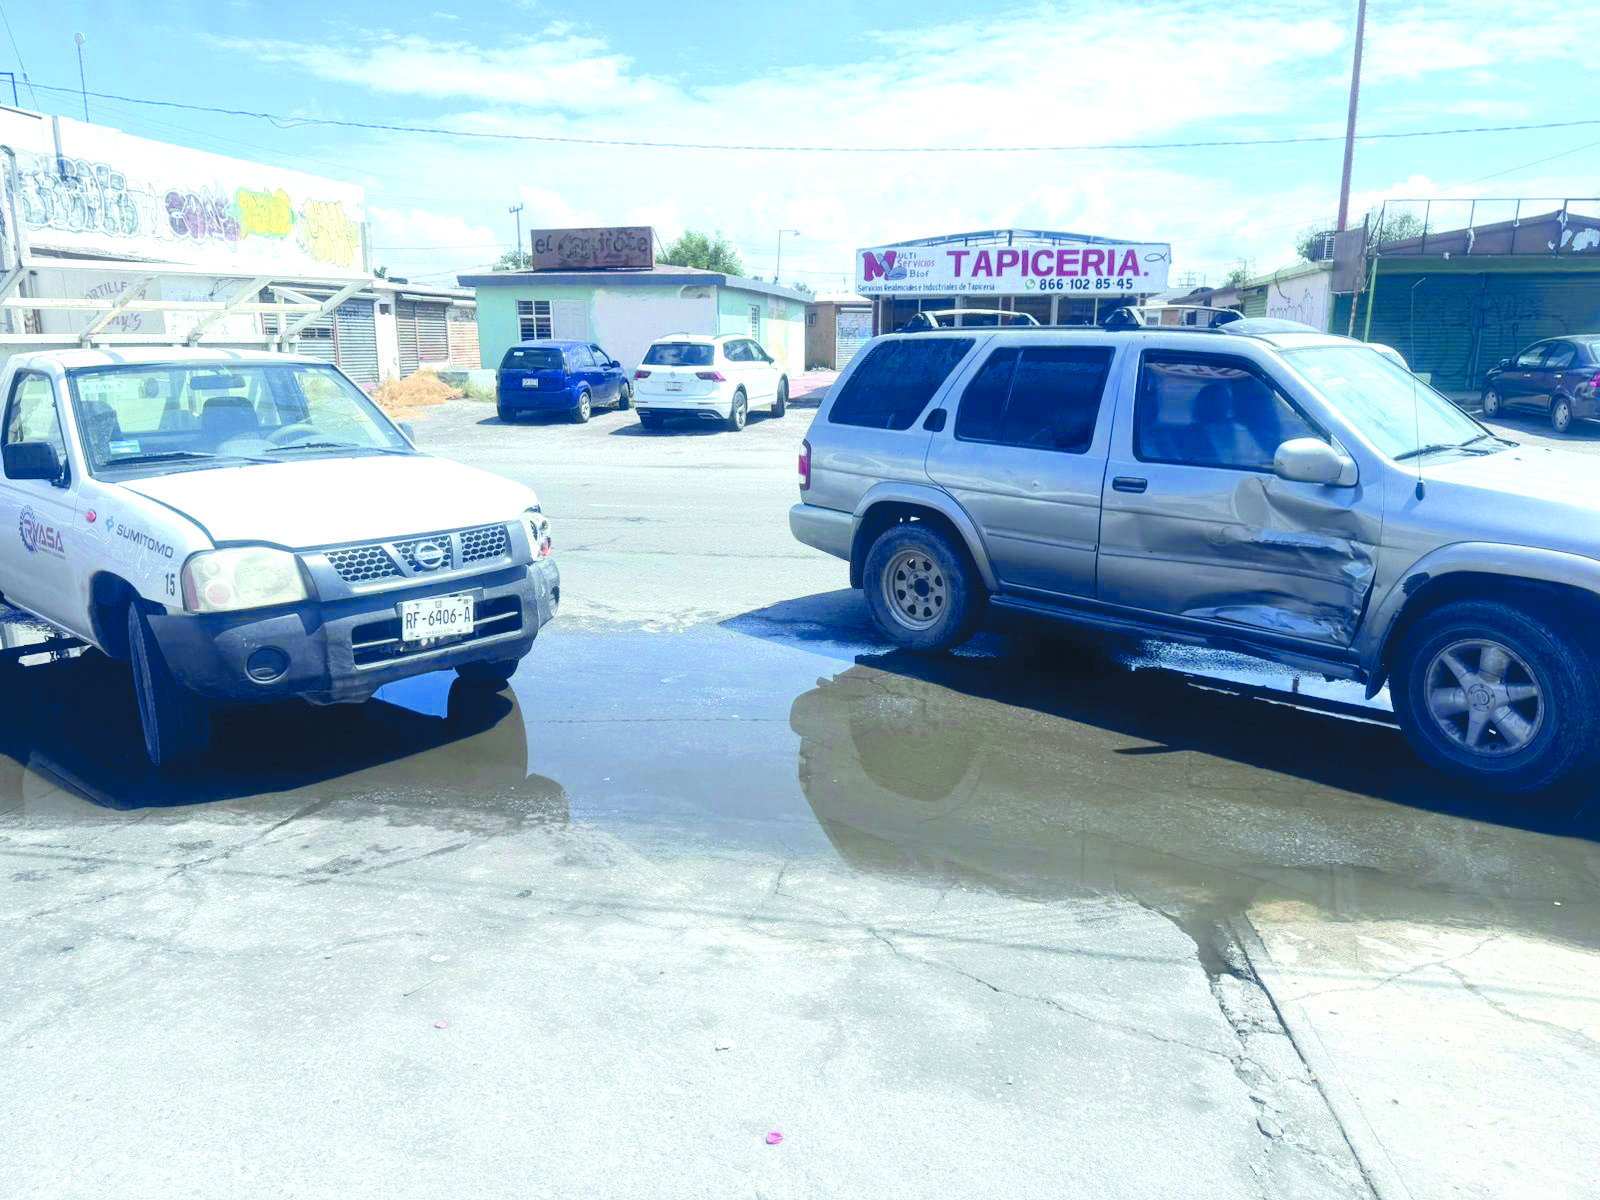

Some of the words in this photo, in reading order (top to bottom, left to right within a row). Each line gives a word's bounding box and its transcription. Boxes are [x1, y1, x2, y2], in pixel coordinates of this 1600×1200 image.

[535, 234, 553, 254] el
[857, 284, 883, 293] Servicios
[922, 283, 958, 291] Industriales
[958, 282, 967, 290] de
[116, 523, 174, 559] SUMITOMO
[165, 571, 176, 597] 15
[405, 606, 471, 630] RF-6406-A
